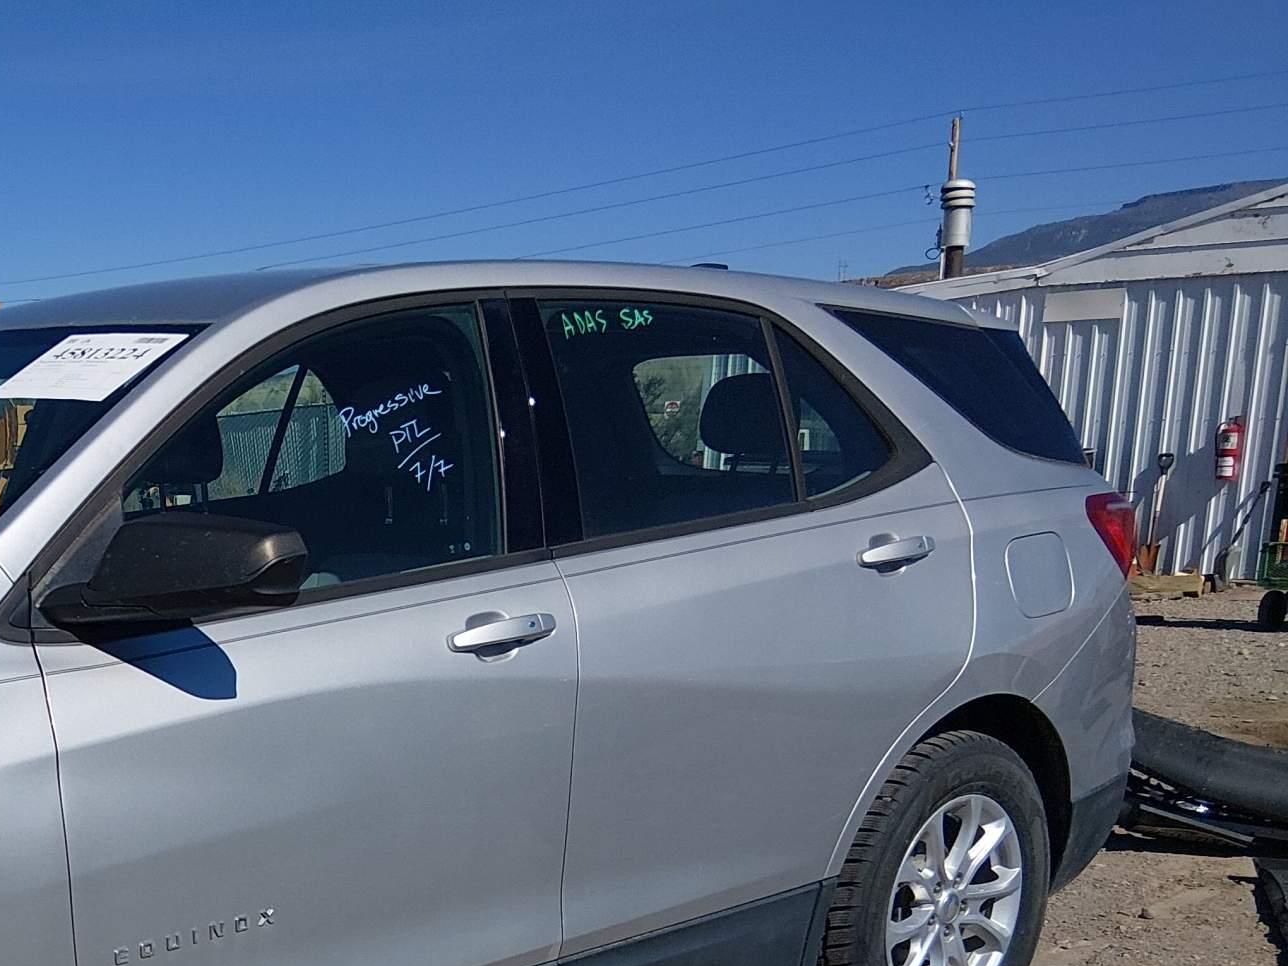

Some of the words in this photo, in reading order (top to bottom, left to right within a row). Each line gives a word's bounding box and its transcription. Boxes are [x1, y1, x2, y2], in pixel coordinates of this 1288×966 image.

[561, 309, 607, 340] ADAS
[53, 347, 152, 360] 45813224
[338, 383, 443, 438] Progressive
[113, 907, 275, 966] EQUINOX
